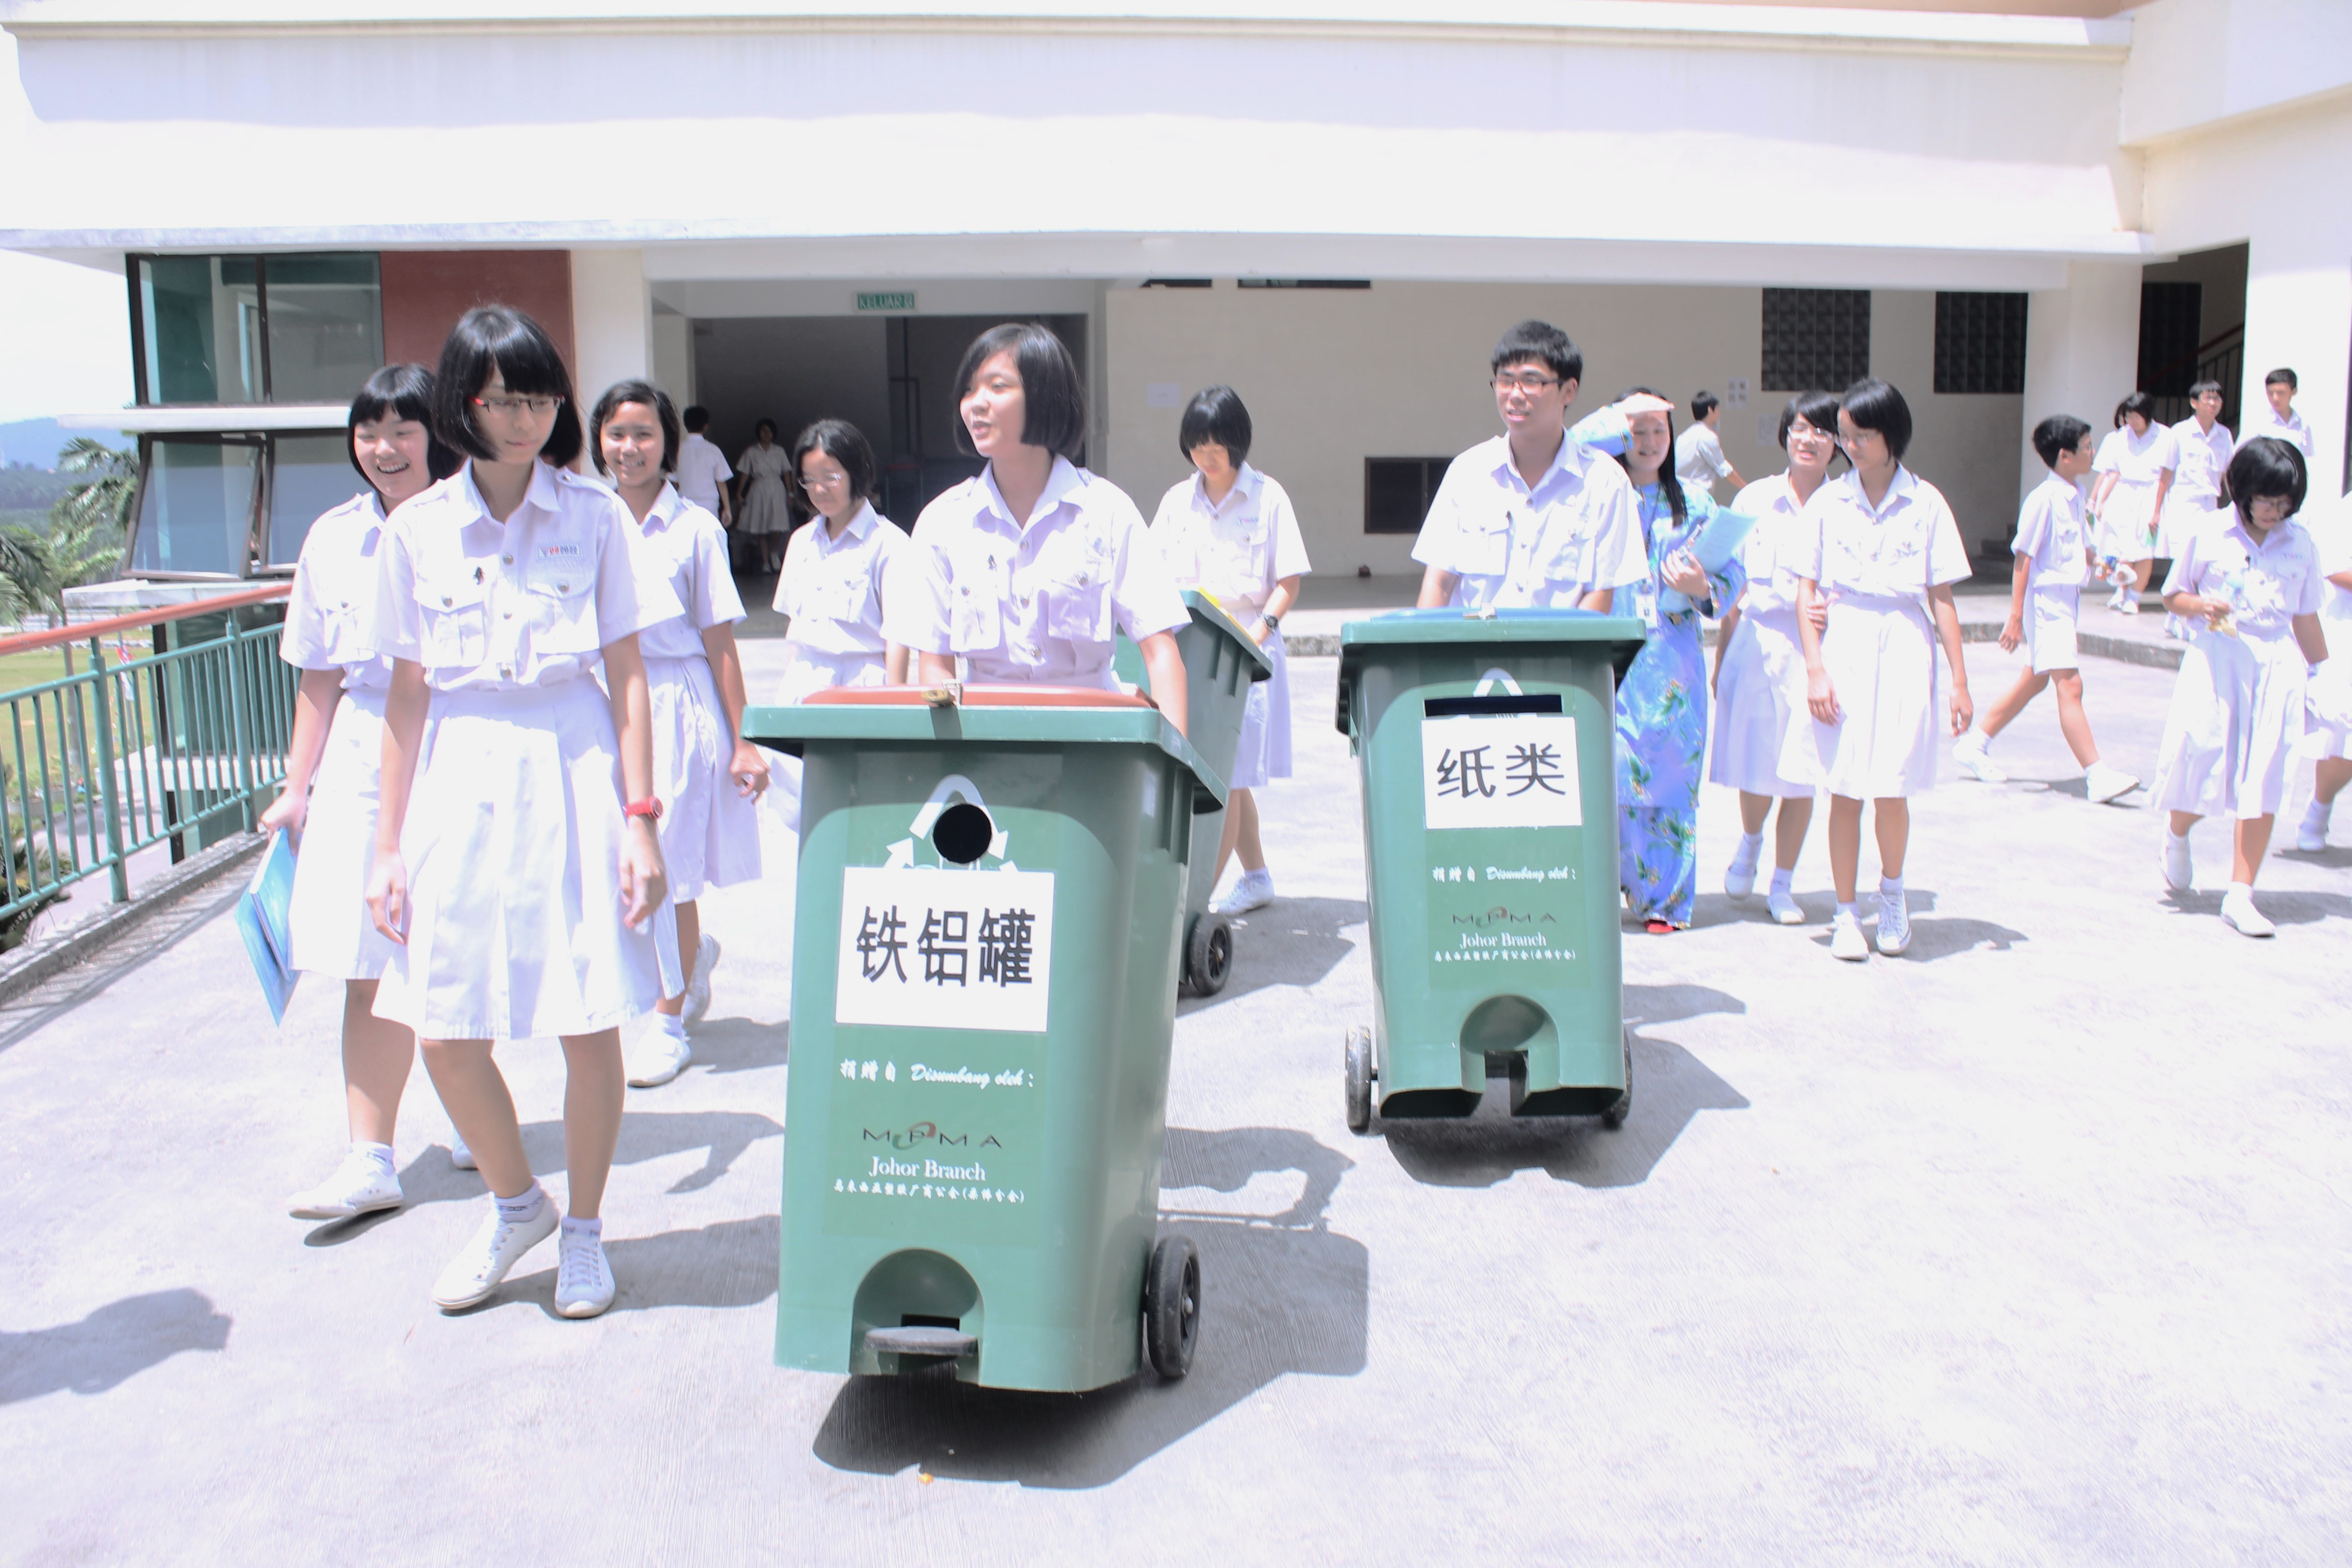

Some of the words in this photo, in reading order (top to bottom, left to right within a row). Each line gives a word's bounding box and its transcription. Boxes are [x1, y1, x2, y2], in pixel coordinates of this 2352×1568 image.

[1437, 743, 1566, 798] 纸类
[856, 905, 1035, 987] 铁铝罐
[1460, 933, 1498, 949] Johor
[1501, 932, 1547, 946] Branch
[911, 1063, 990, 1089] Disumbang
[869, 1156, 920, 1177] Johor
[924, 1159, 986, 1181] Branch
